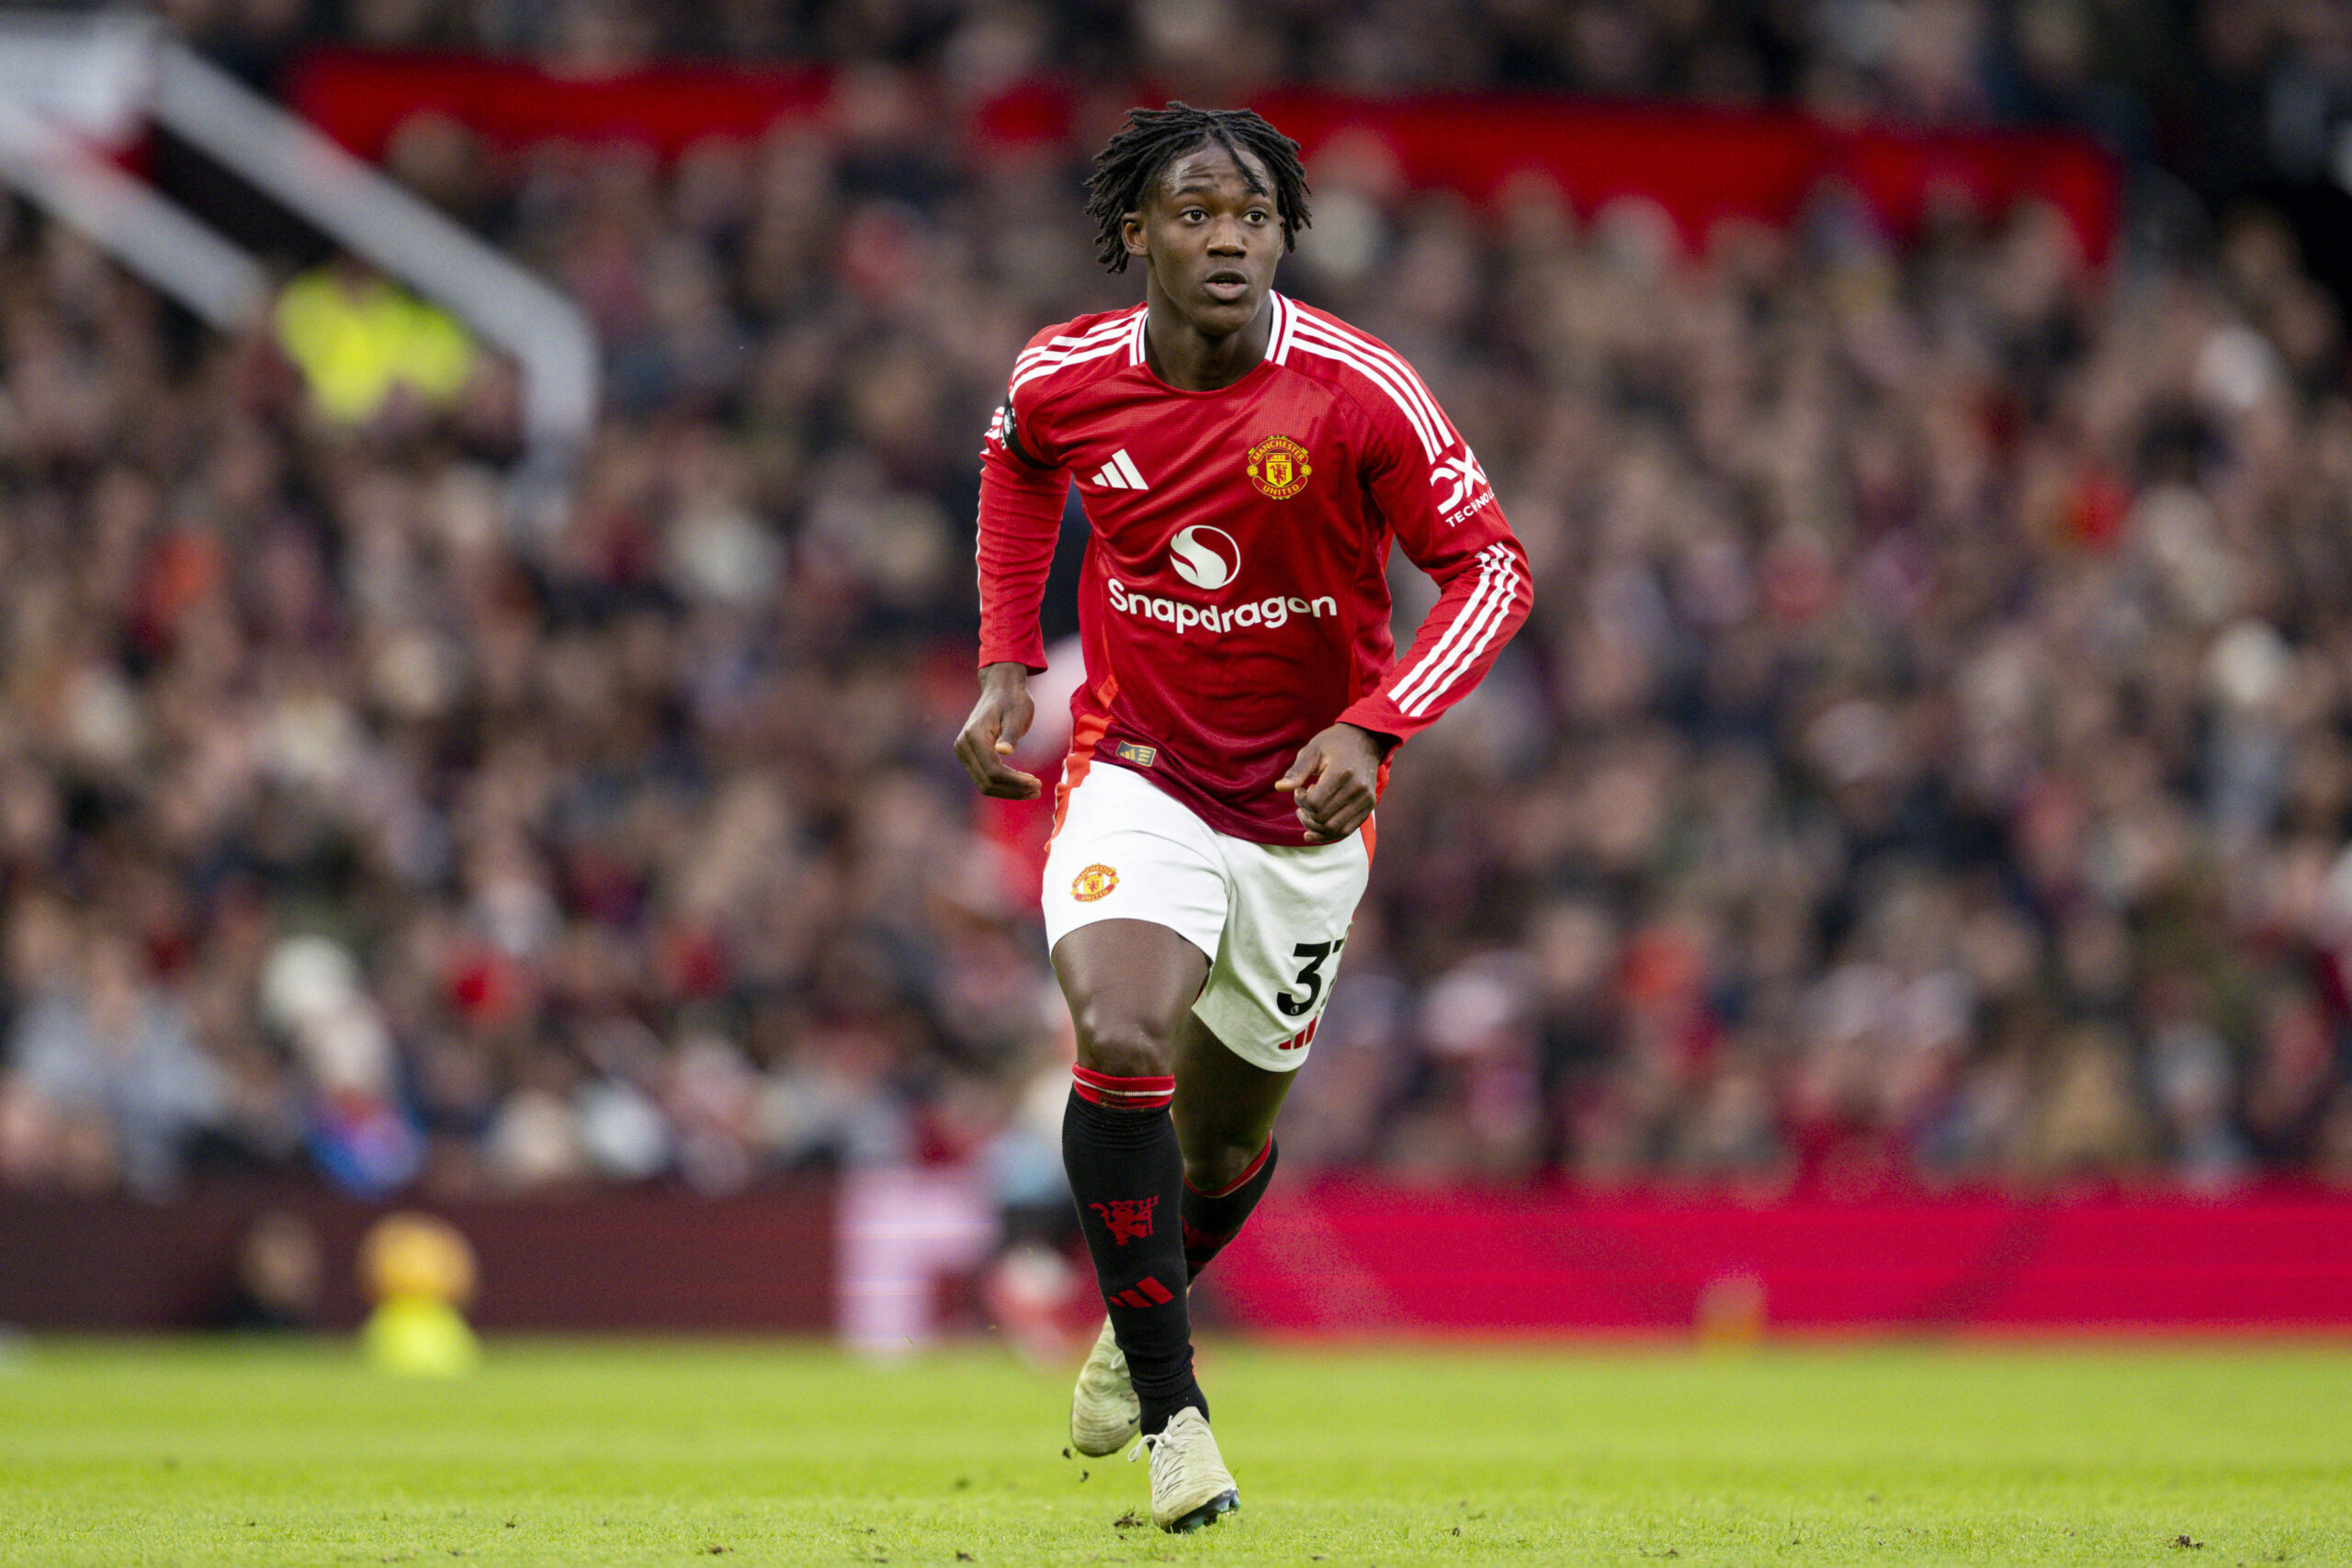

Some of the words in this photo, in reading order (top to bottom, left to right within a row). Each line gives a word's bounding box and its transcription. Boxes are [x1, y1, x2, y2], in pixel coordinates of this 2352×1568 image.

[1252, 441, 1305, 461] MANCHESTER
[1262, 484, 1299, 495] UNITED
[1108, 578, 1337, 634] Snapdragon
[1277, 938, 1345, 1016] 3
